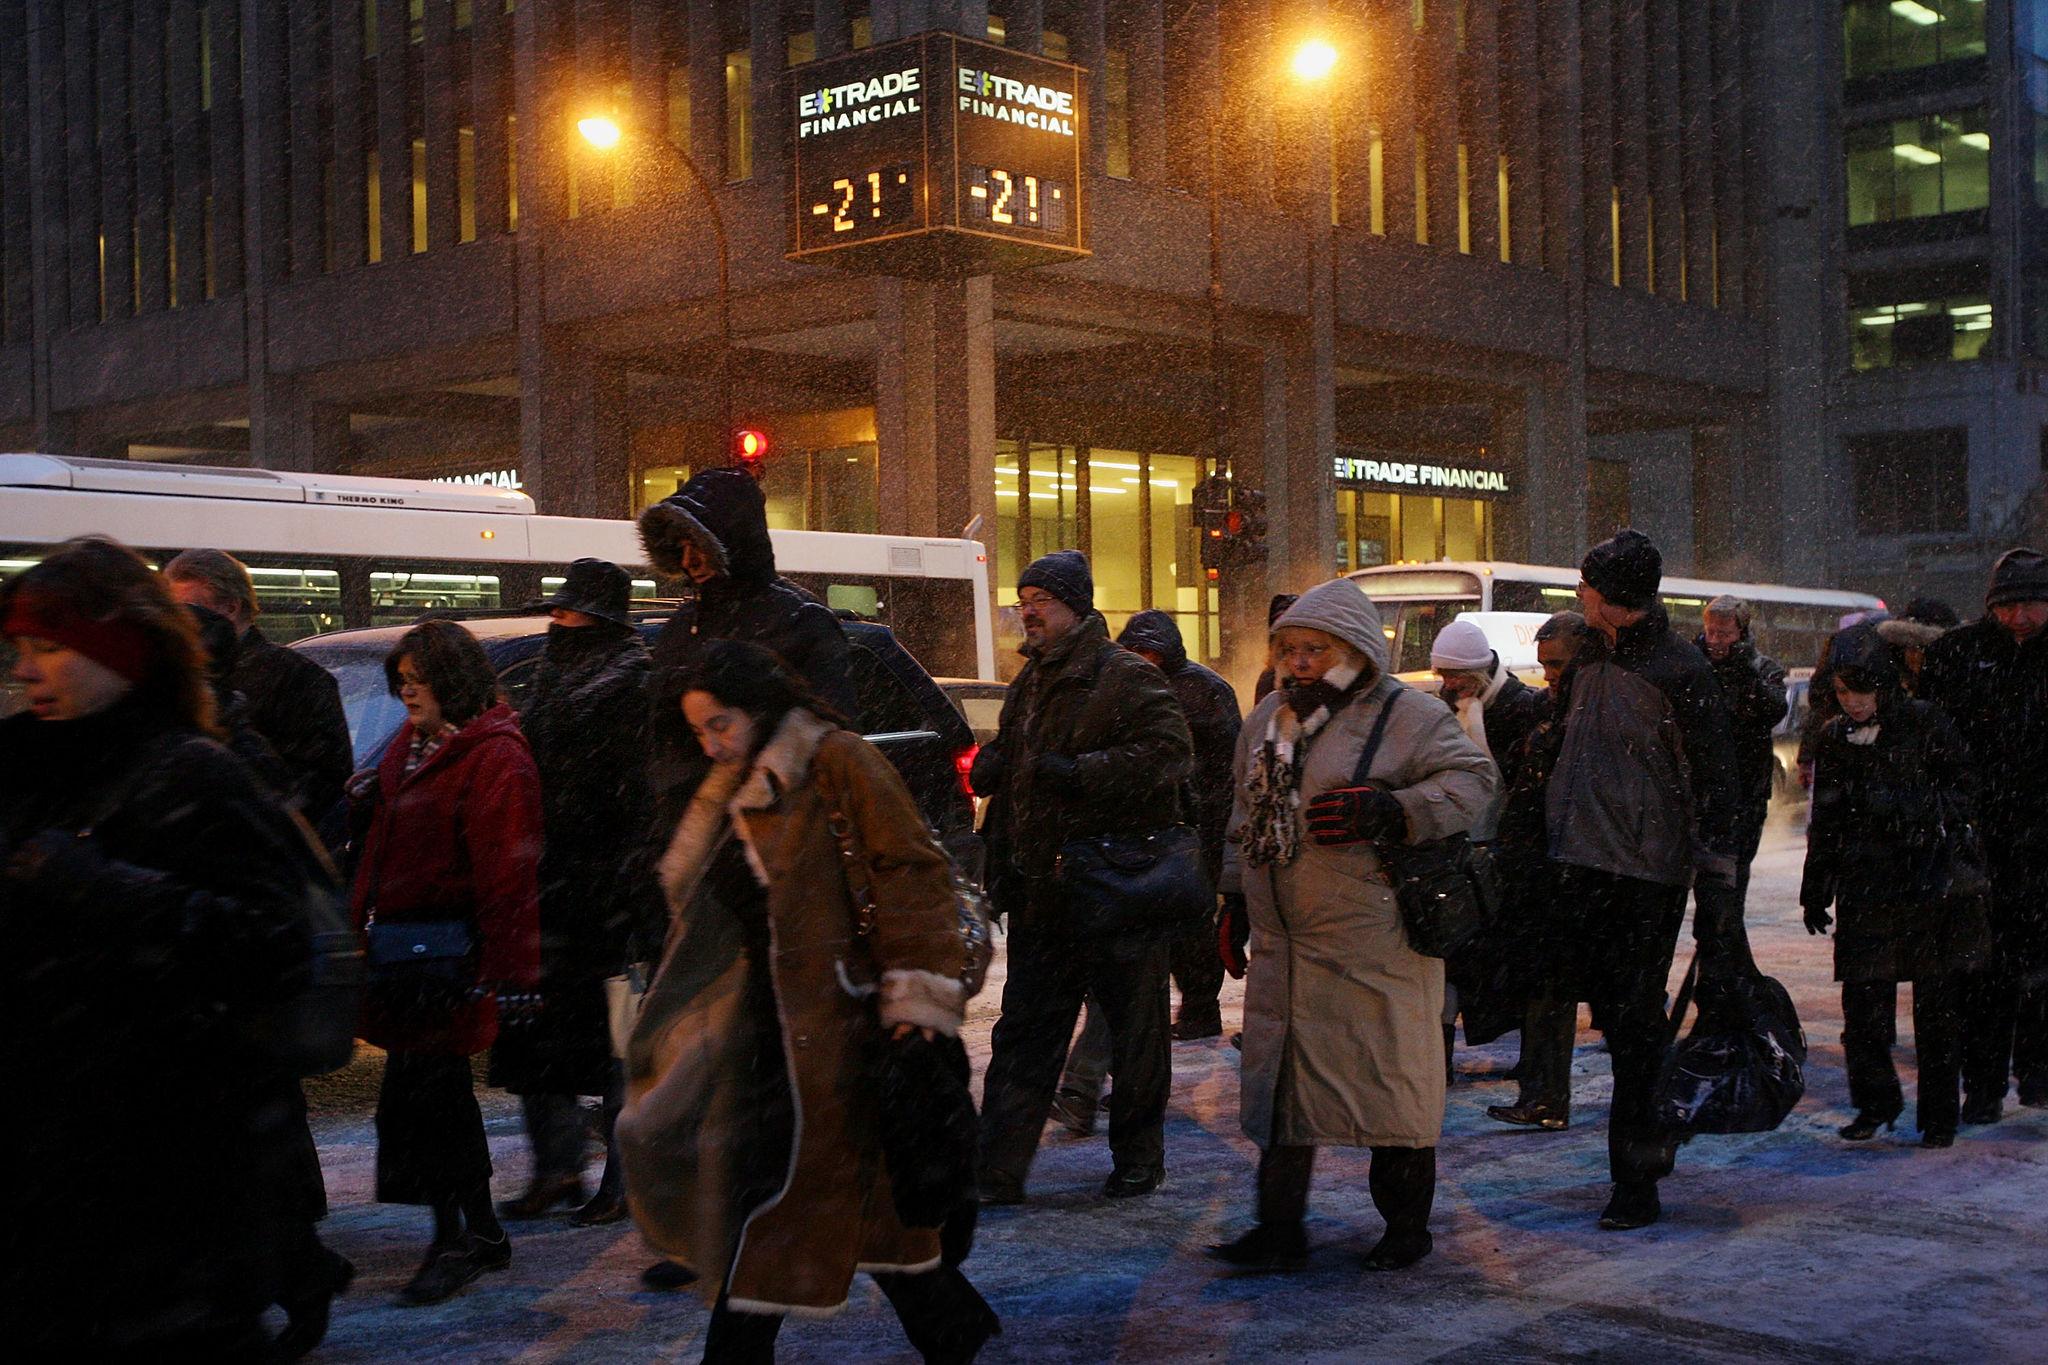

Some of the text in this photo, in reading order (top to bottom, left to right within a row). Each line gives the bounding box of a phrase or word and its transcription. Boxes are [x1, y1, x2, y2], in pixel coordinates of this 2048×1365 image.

[800, 98, 921, 138] FINANCIAL
[959, 96, 1074, 136] FINANCIAL
[1419, 465, 1509, 491] FINANCIAL
[337, 495, 377, 504] THERMO
